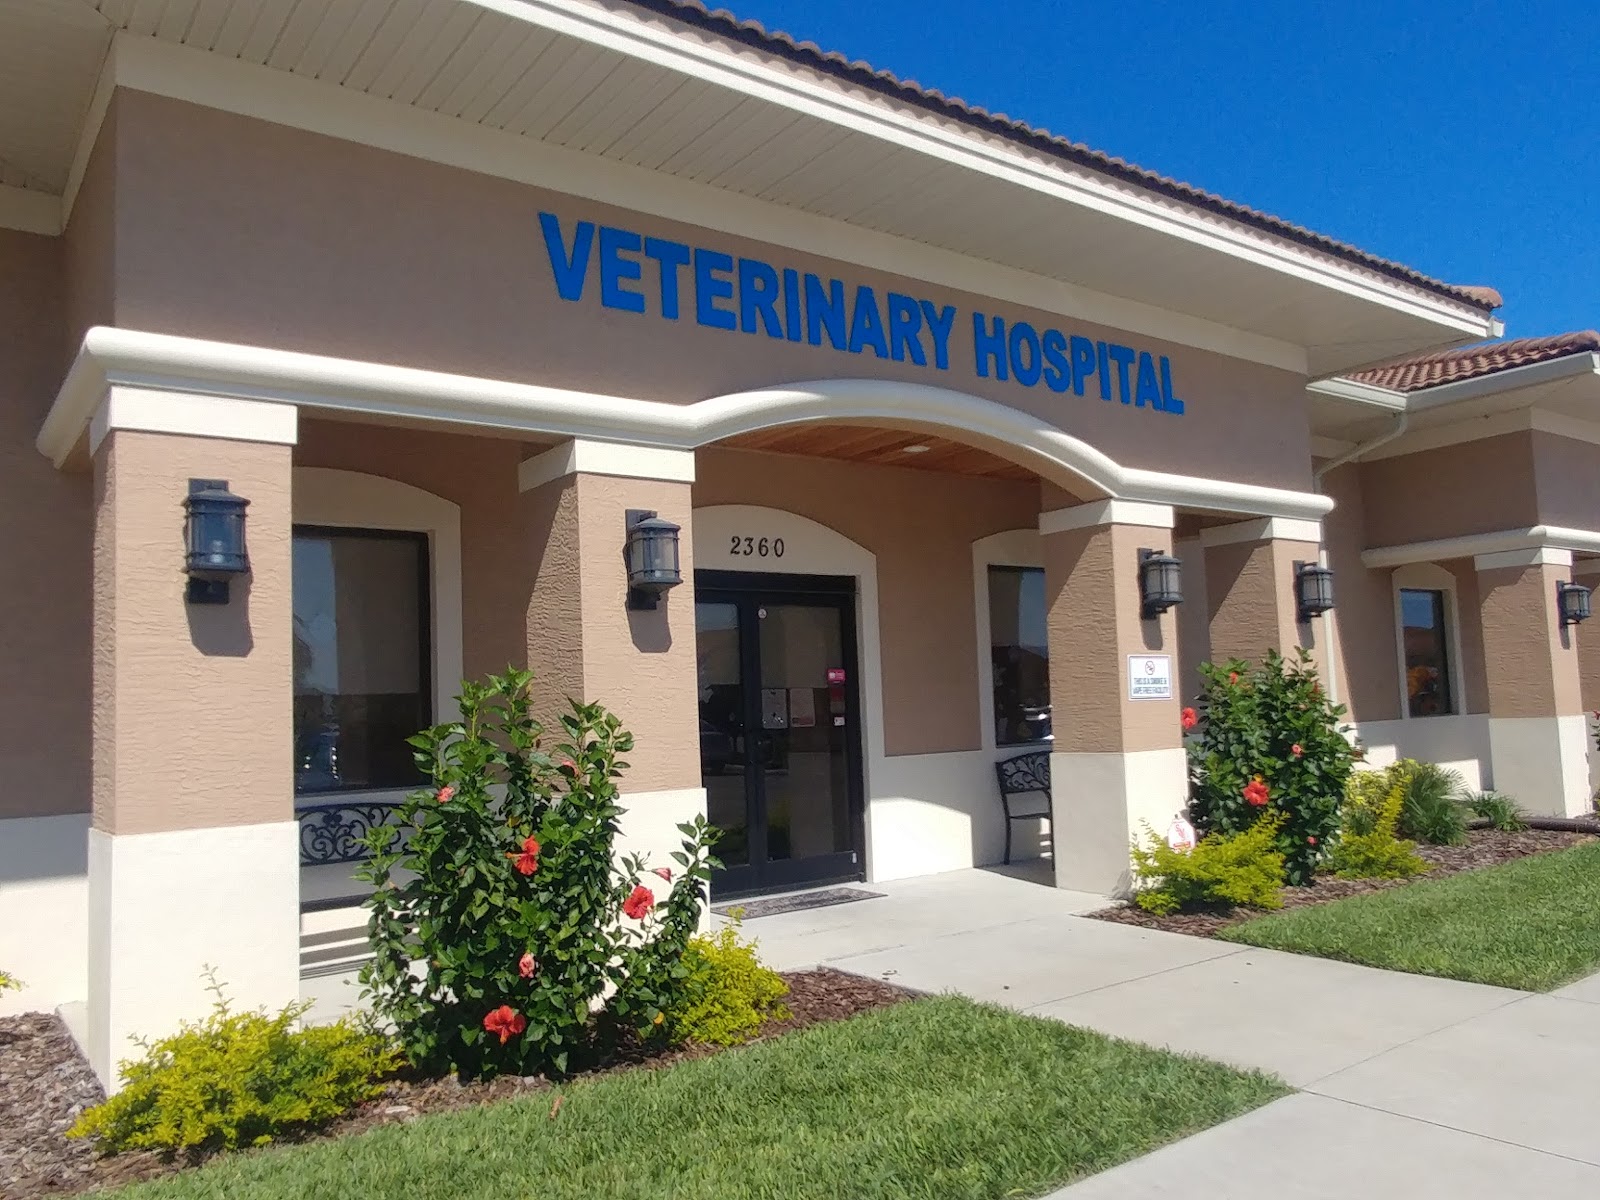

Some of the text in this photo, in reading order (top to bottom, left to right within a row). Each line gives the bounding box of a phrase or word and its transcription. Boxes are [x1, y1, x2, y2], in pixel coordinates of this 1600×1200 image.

[539, 212, 1185, 415] VETERINARY HOSPITAL
[730, 535, 785, 557] 2360
